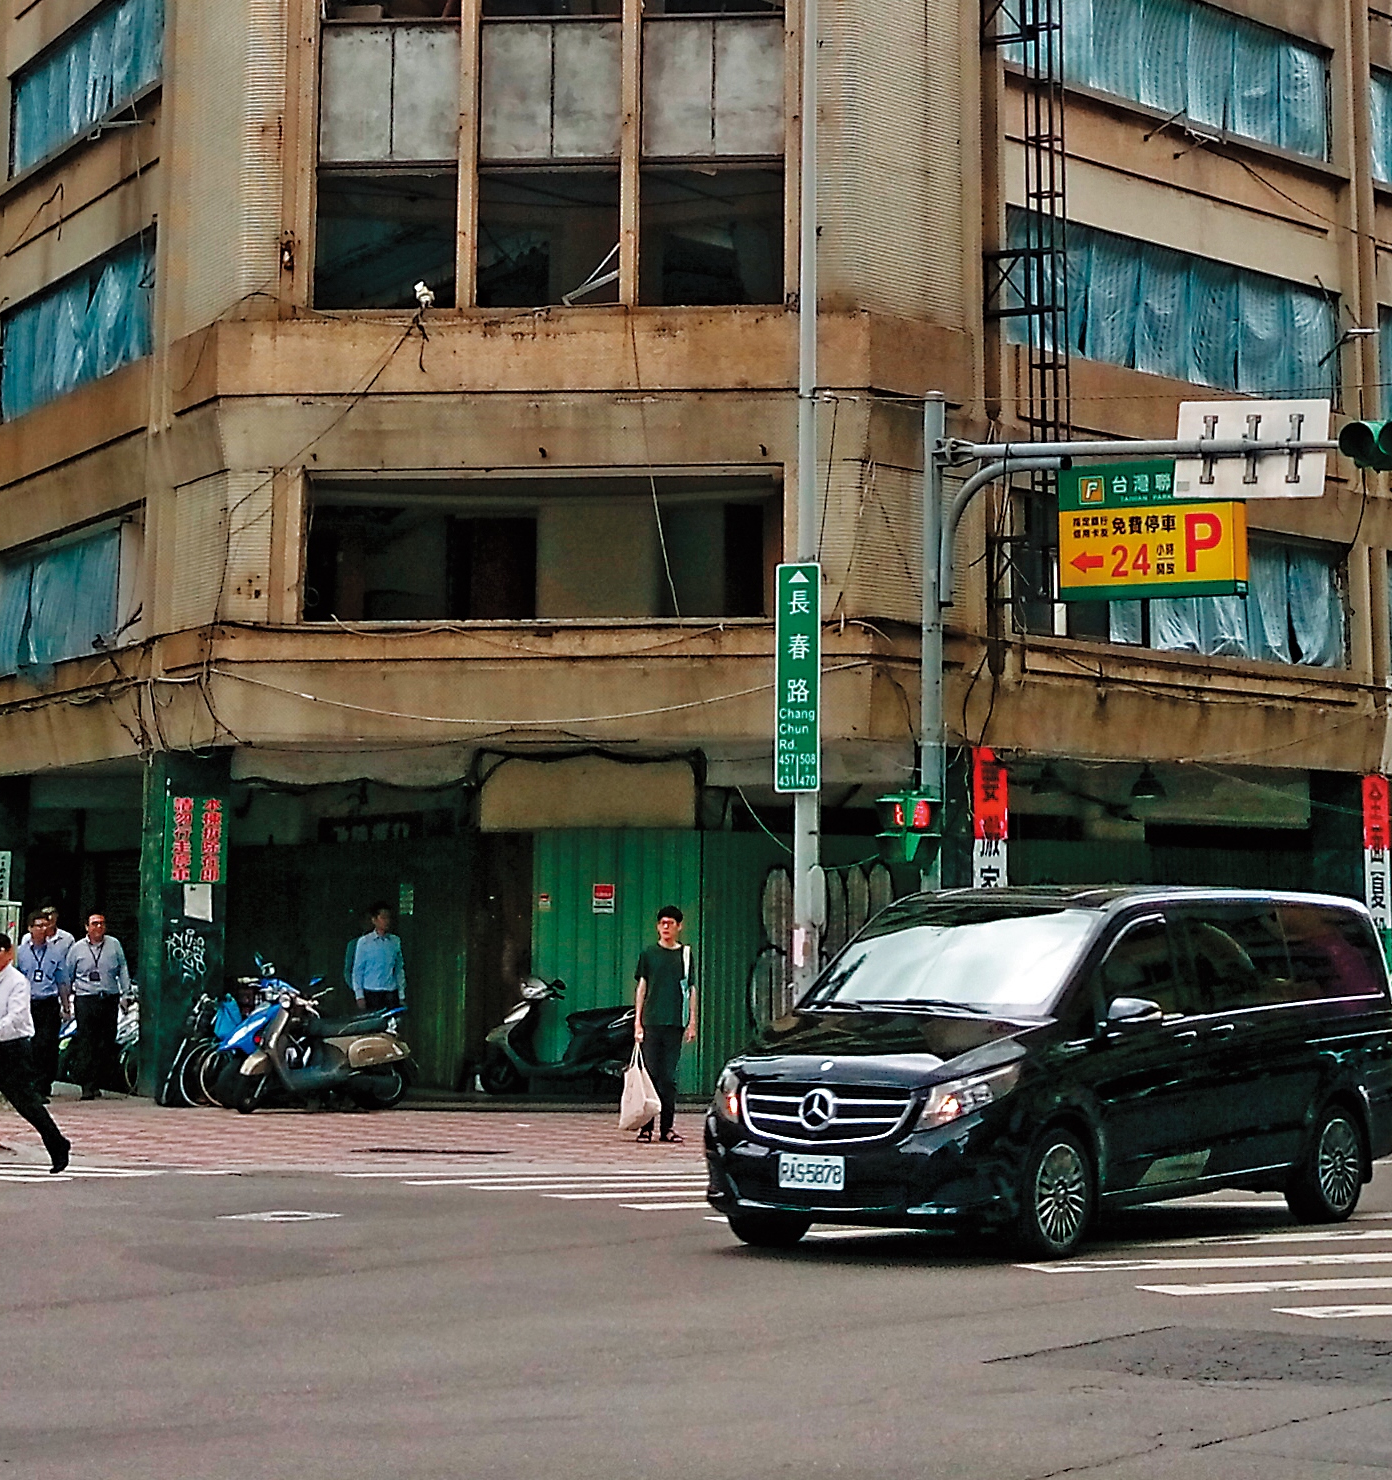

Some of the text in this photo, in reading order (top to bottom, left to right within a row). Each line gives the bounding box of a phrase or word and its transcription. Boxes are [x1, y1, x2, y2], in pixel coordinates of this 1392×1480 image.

[1111, 514, 1177, 535] 免費停車
[1185, 511, 1223, 573] P
[1111, 543, 1151, 578] 24
[787, 590, 810, 703] 長春路
[779, 708, 815, 721] Chang
[779, 723, 809, 734] Chun
[779, 739, 798, 750] Rd.
[778, 753, 816, 765] 457 508
[778, 775, 816, 786] 431 470
